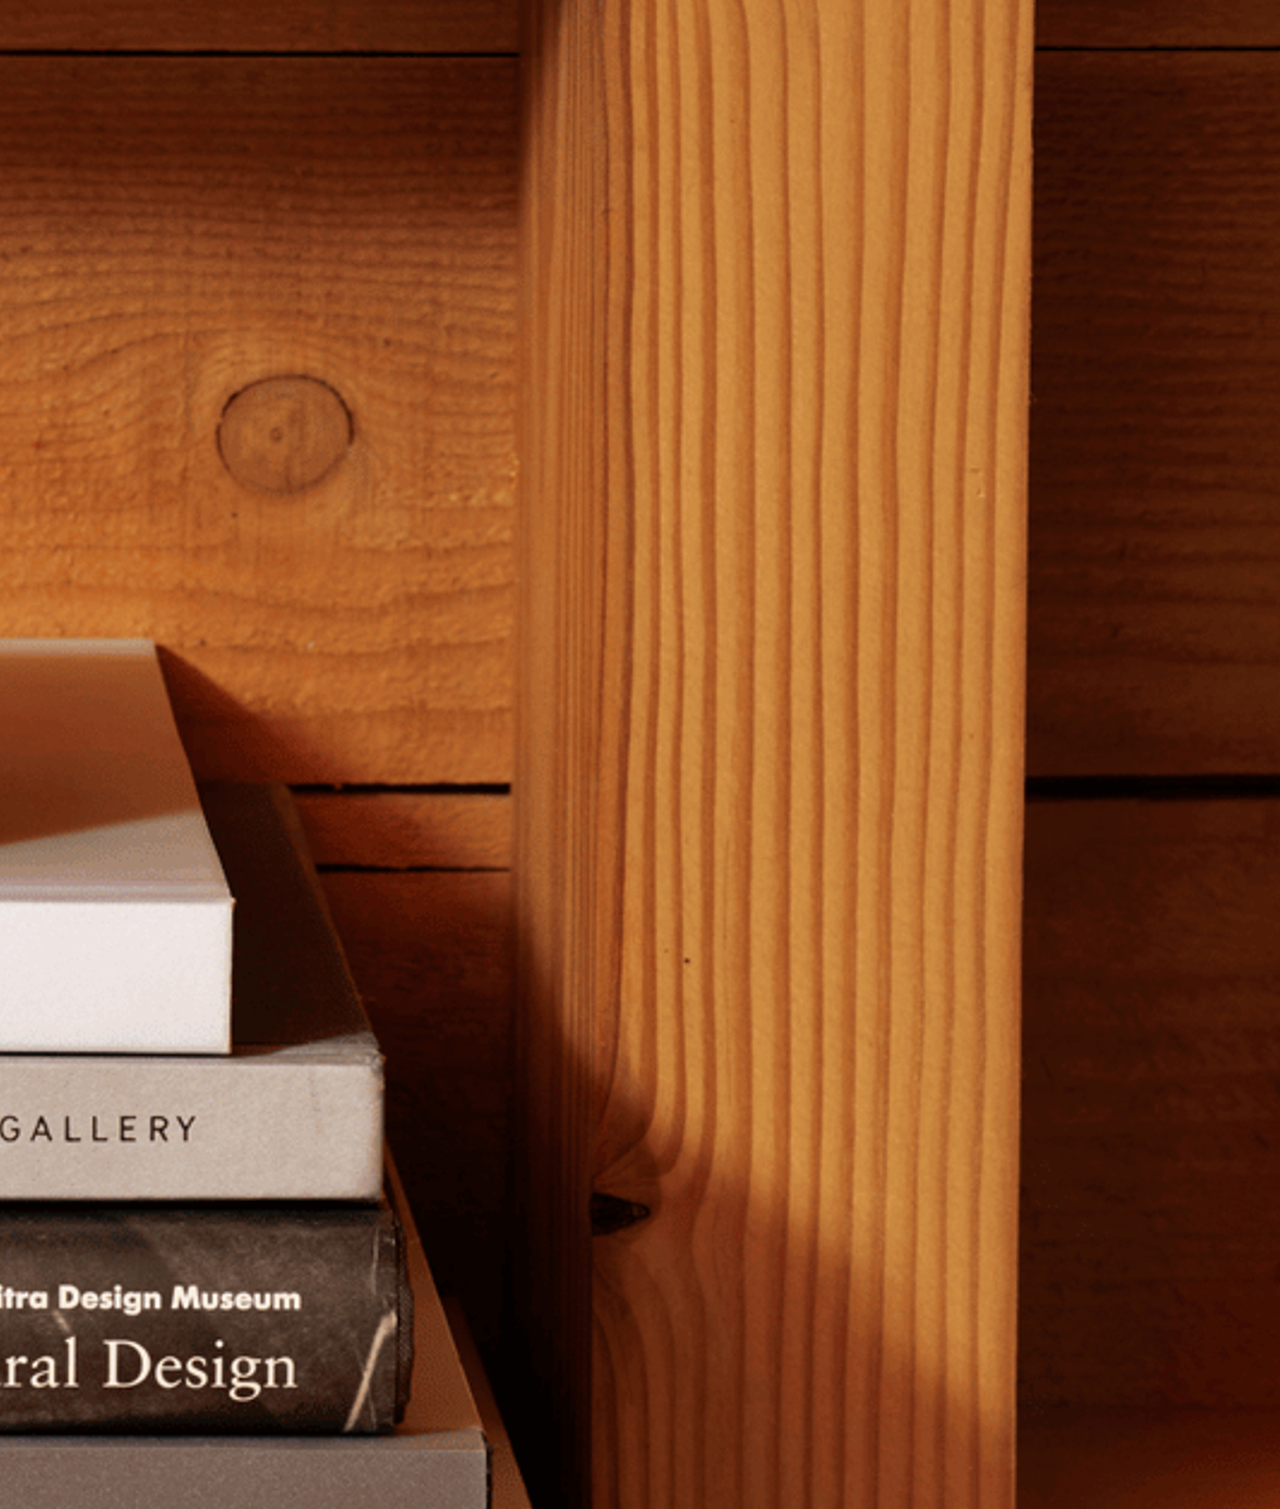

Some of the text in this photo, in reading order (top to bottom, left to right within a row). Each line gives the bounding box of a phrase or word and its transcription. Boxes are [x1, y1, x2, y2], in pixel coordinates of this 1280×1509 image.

[58, 1284, 162, 1315] Design
[172, 1286, 301, 1311] Museum
[101, 1340, 298, 1401] Design
